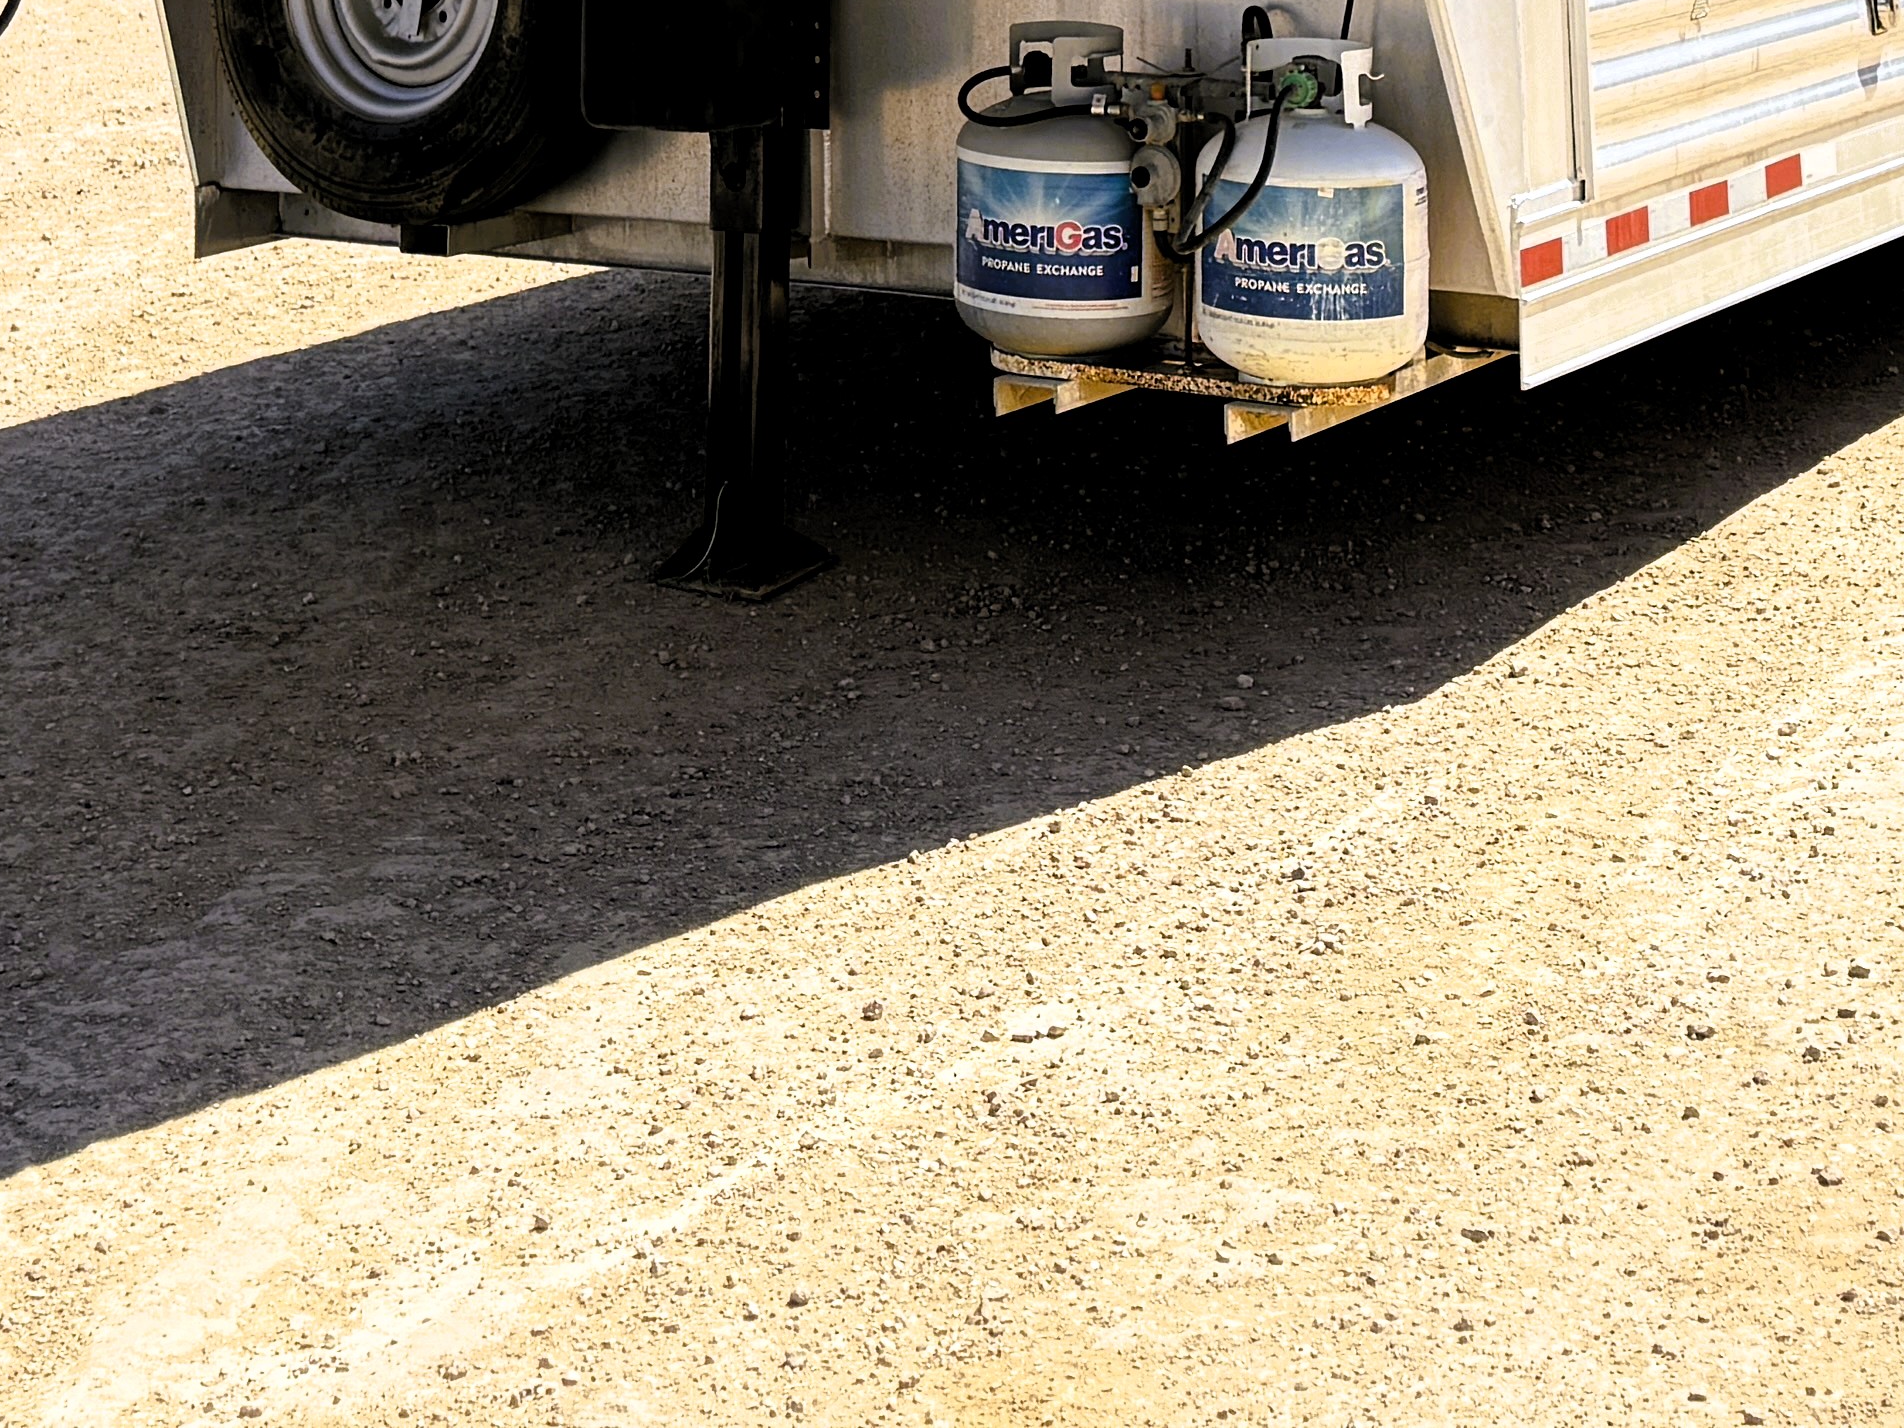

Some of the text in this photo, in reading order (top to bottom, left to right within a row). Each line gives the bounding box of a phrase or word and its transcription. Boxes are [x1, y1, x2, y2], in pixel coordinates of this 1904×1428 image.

[965, 208, 1125, 256] AmeriGas
[981, 255, 1104, 277] PROPANE EXCHANGE
[1234, 276, 1368, 295] PROPANE EXCHANGE
